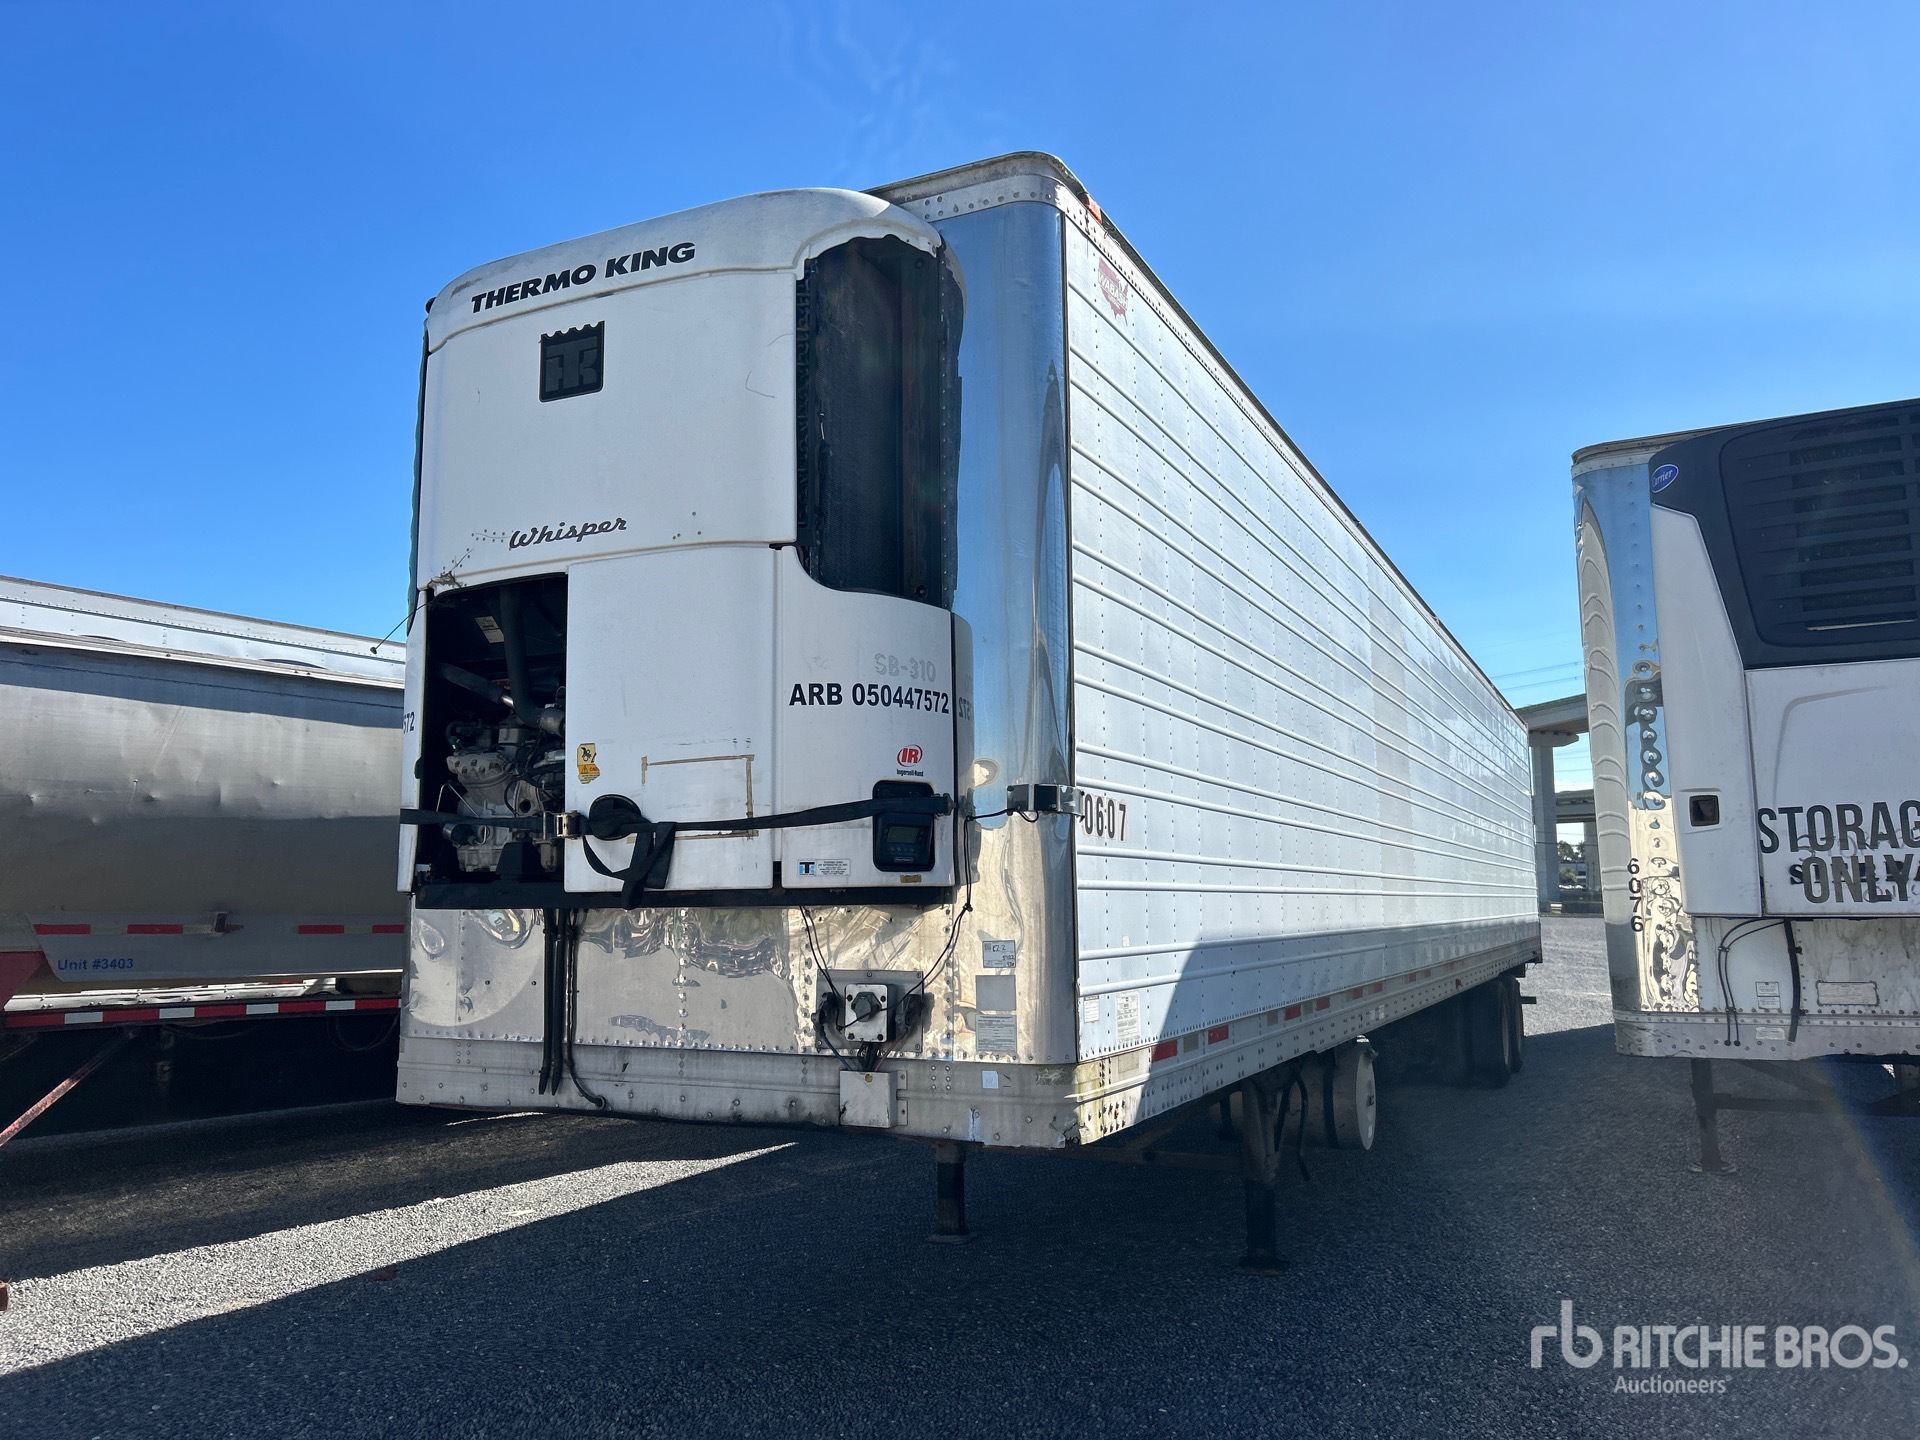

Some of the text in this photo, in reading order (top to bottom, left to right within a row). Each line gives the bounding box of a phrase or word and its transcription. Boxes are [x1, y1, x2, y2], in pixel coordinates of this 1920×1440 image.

[472, 242, 696, 314] THERMO KING
[509, 517, 627, 549] Whisper
[874, 653, 937, 683] SB-310
[788, 683, 950, 715] ARB 050447572
[901, 747, 920, 764] IR
[1084, 793, 1127, 842] 0607
[1802, 853, 1914, 904] ONLY
[57, 958, 134, 971] Unit #3403
